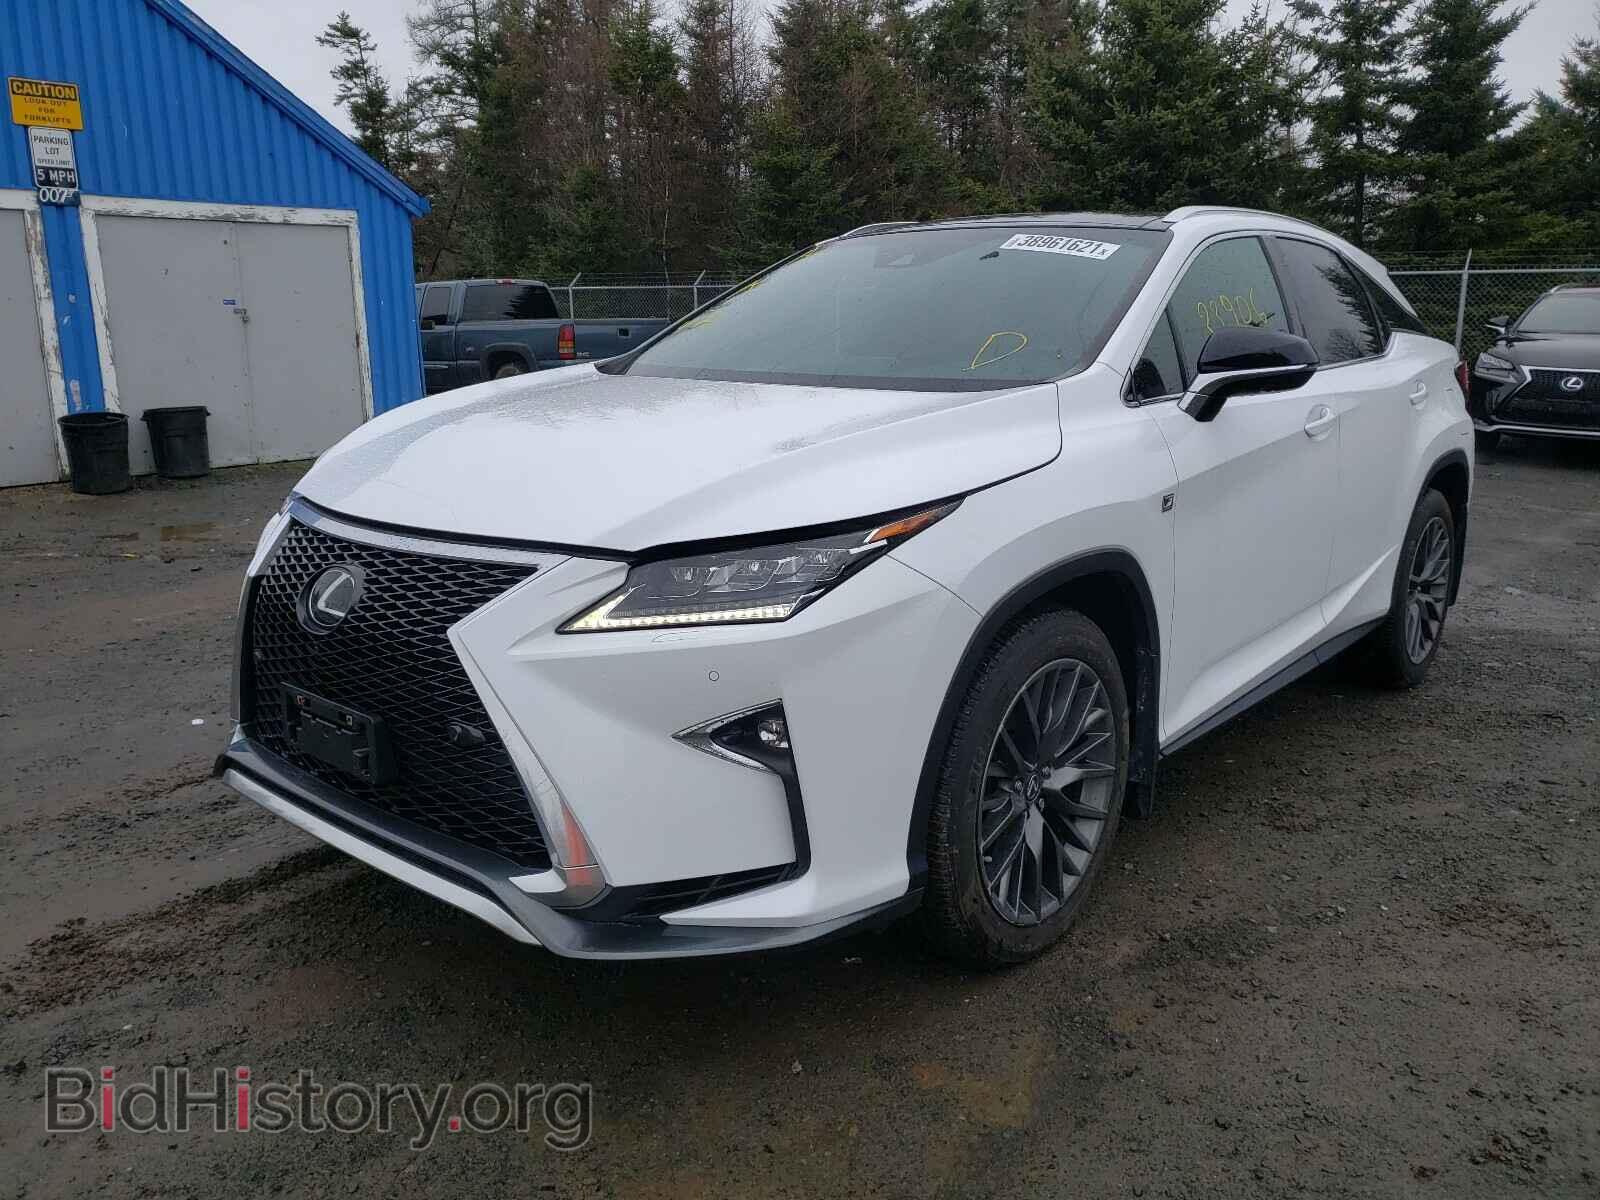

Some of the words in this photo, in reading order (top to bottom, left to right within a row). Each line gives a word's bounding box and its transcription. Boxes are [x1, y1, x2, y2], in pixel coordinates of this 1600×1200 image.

[12, 81, 76, 99] CAUTION
[33, 135, 69, 146] PARKING
[45, 147, 60, 156] LOT
[37, 168, 46, 181] 5
[49, 170, 75, 183] MPH
